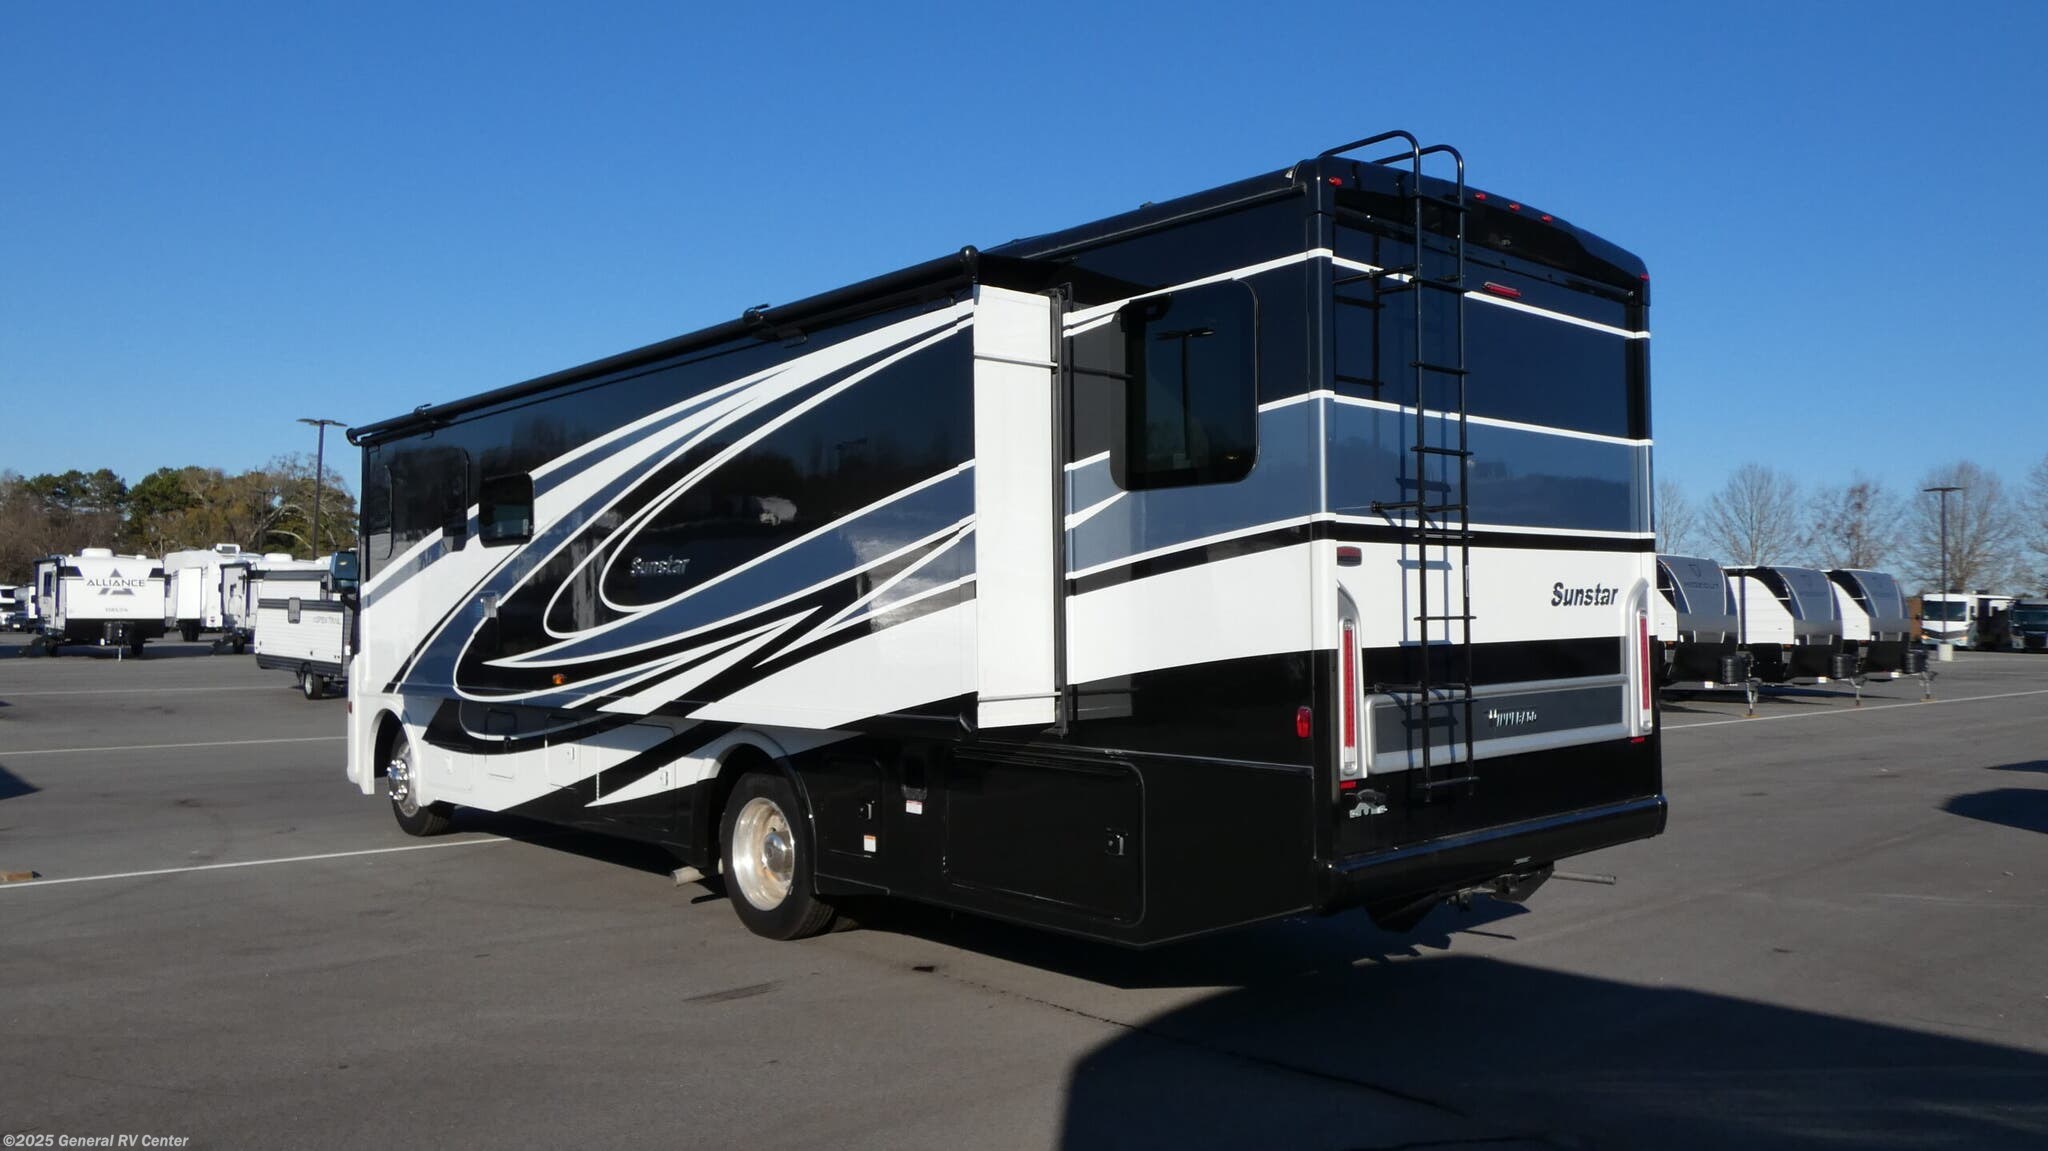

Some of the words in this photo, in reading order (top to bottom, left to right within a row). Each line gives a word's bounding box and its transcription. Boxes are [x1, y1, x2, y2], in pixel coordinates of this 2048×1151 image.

[630, 555, 690, 576] Sunstar
[86, 579, 145, 587] ALLIANCE
[1551, 582, 1619, 606] Sunstar
